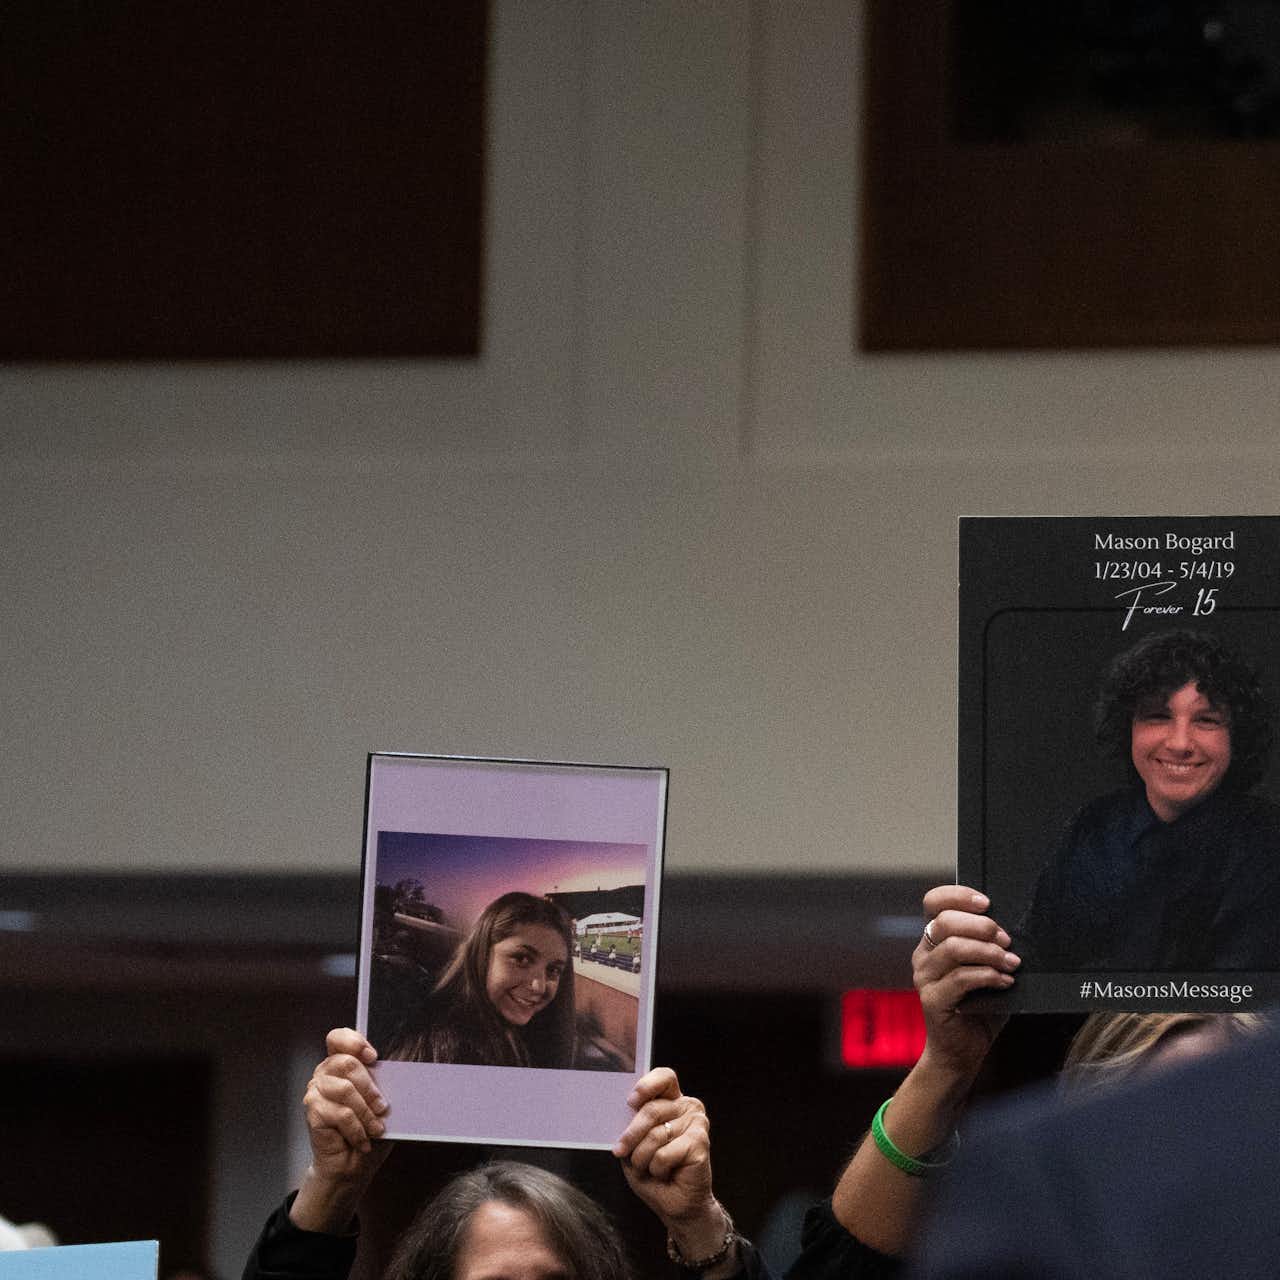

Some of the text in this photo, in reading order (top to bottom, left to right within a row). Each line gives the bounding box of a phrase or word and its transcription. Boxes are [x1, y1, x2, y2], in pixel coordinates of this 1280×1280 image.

[1094, 531, 1235, 556] Mason Bogard
[1094, 561, 1162, 580] 1/23/04
[1179, 561, 1236, 580] 5/4/19
[1114, 581, 1219, 632] Forever 15
[1079, 981, 1254, 1004] #MasonsMessage
